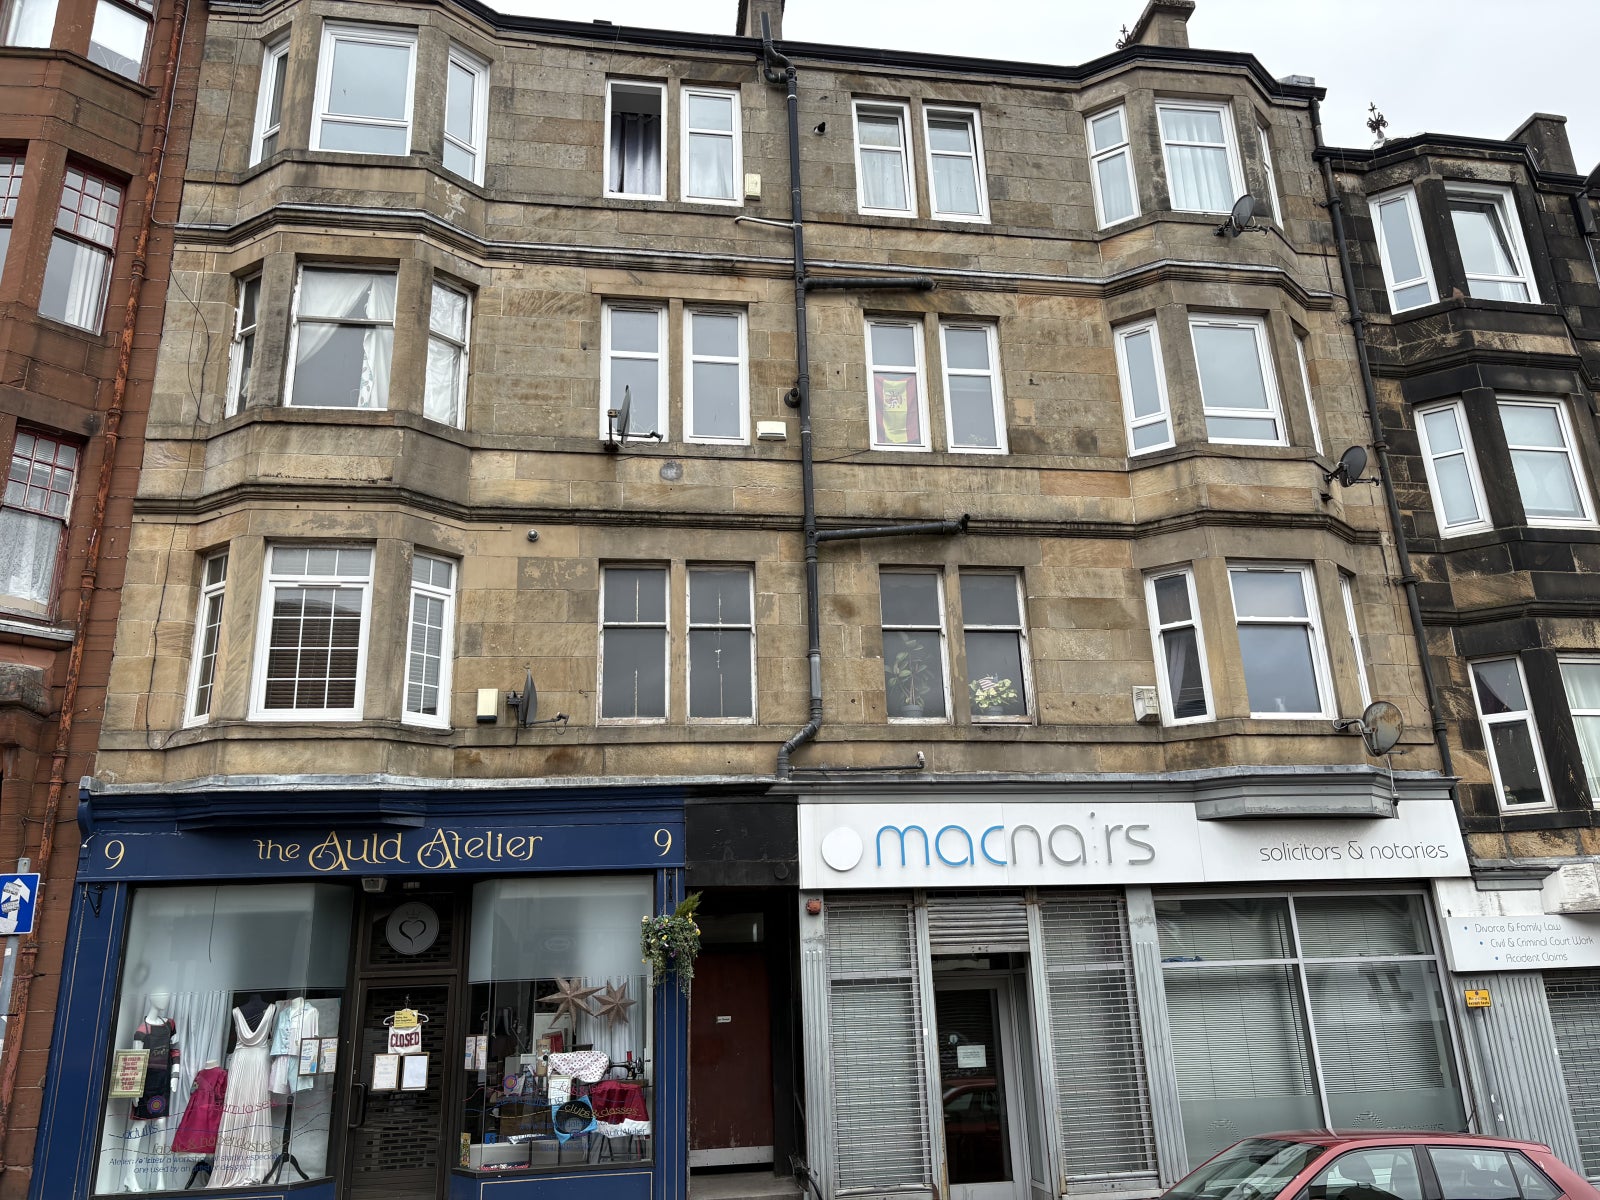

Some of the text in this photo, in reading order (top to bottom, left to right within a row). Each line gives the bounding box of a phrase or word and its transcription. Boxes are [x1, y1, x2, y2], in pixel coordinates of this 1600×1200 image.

[253, 828, 543, 872] the Auld Atelier
[654, 829, 673, 855] 9
[105, 841, 126, 869] 9
[1259, 840, 1449, 862] solicitors & notaries
[1474, 921, 1562, 934] Divorce & Family Law
[1490, 935, 1595, 948] Civil & Criminal Court Work
[1505, 952, 1569, 963] Accident Claims
[390, 1031, 420, 1048] CLOSED
[564, 1104, 591, 1118] clubs
[600, 1106, 640, 1118] classes
